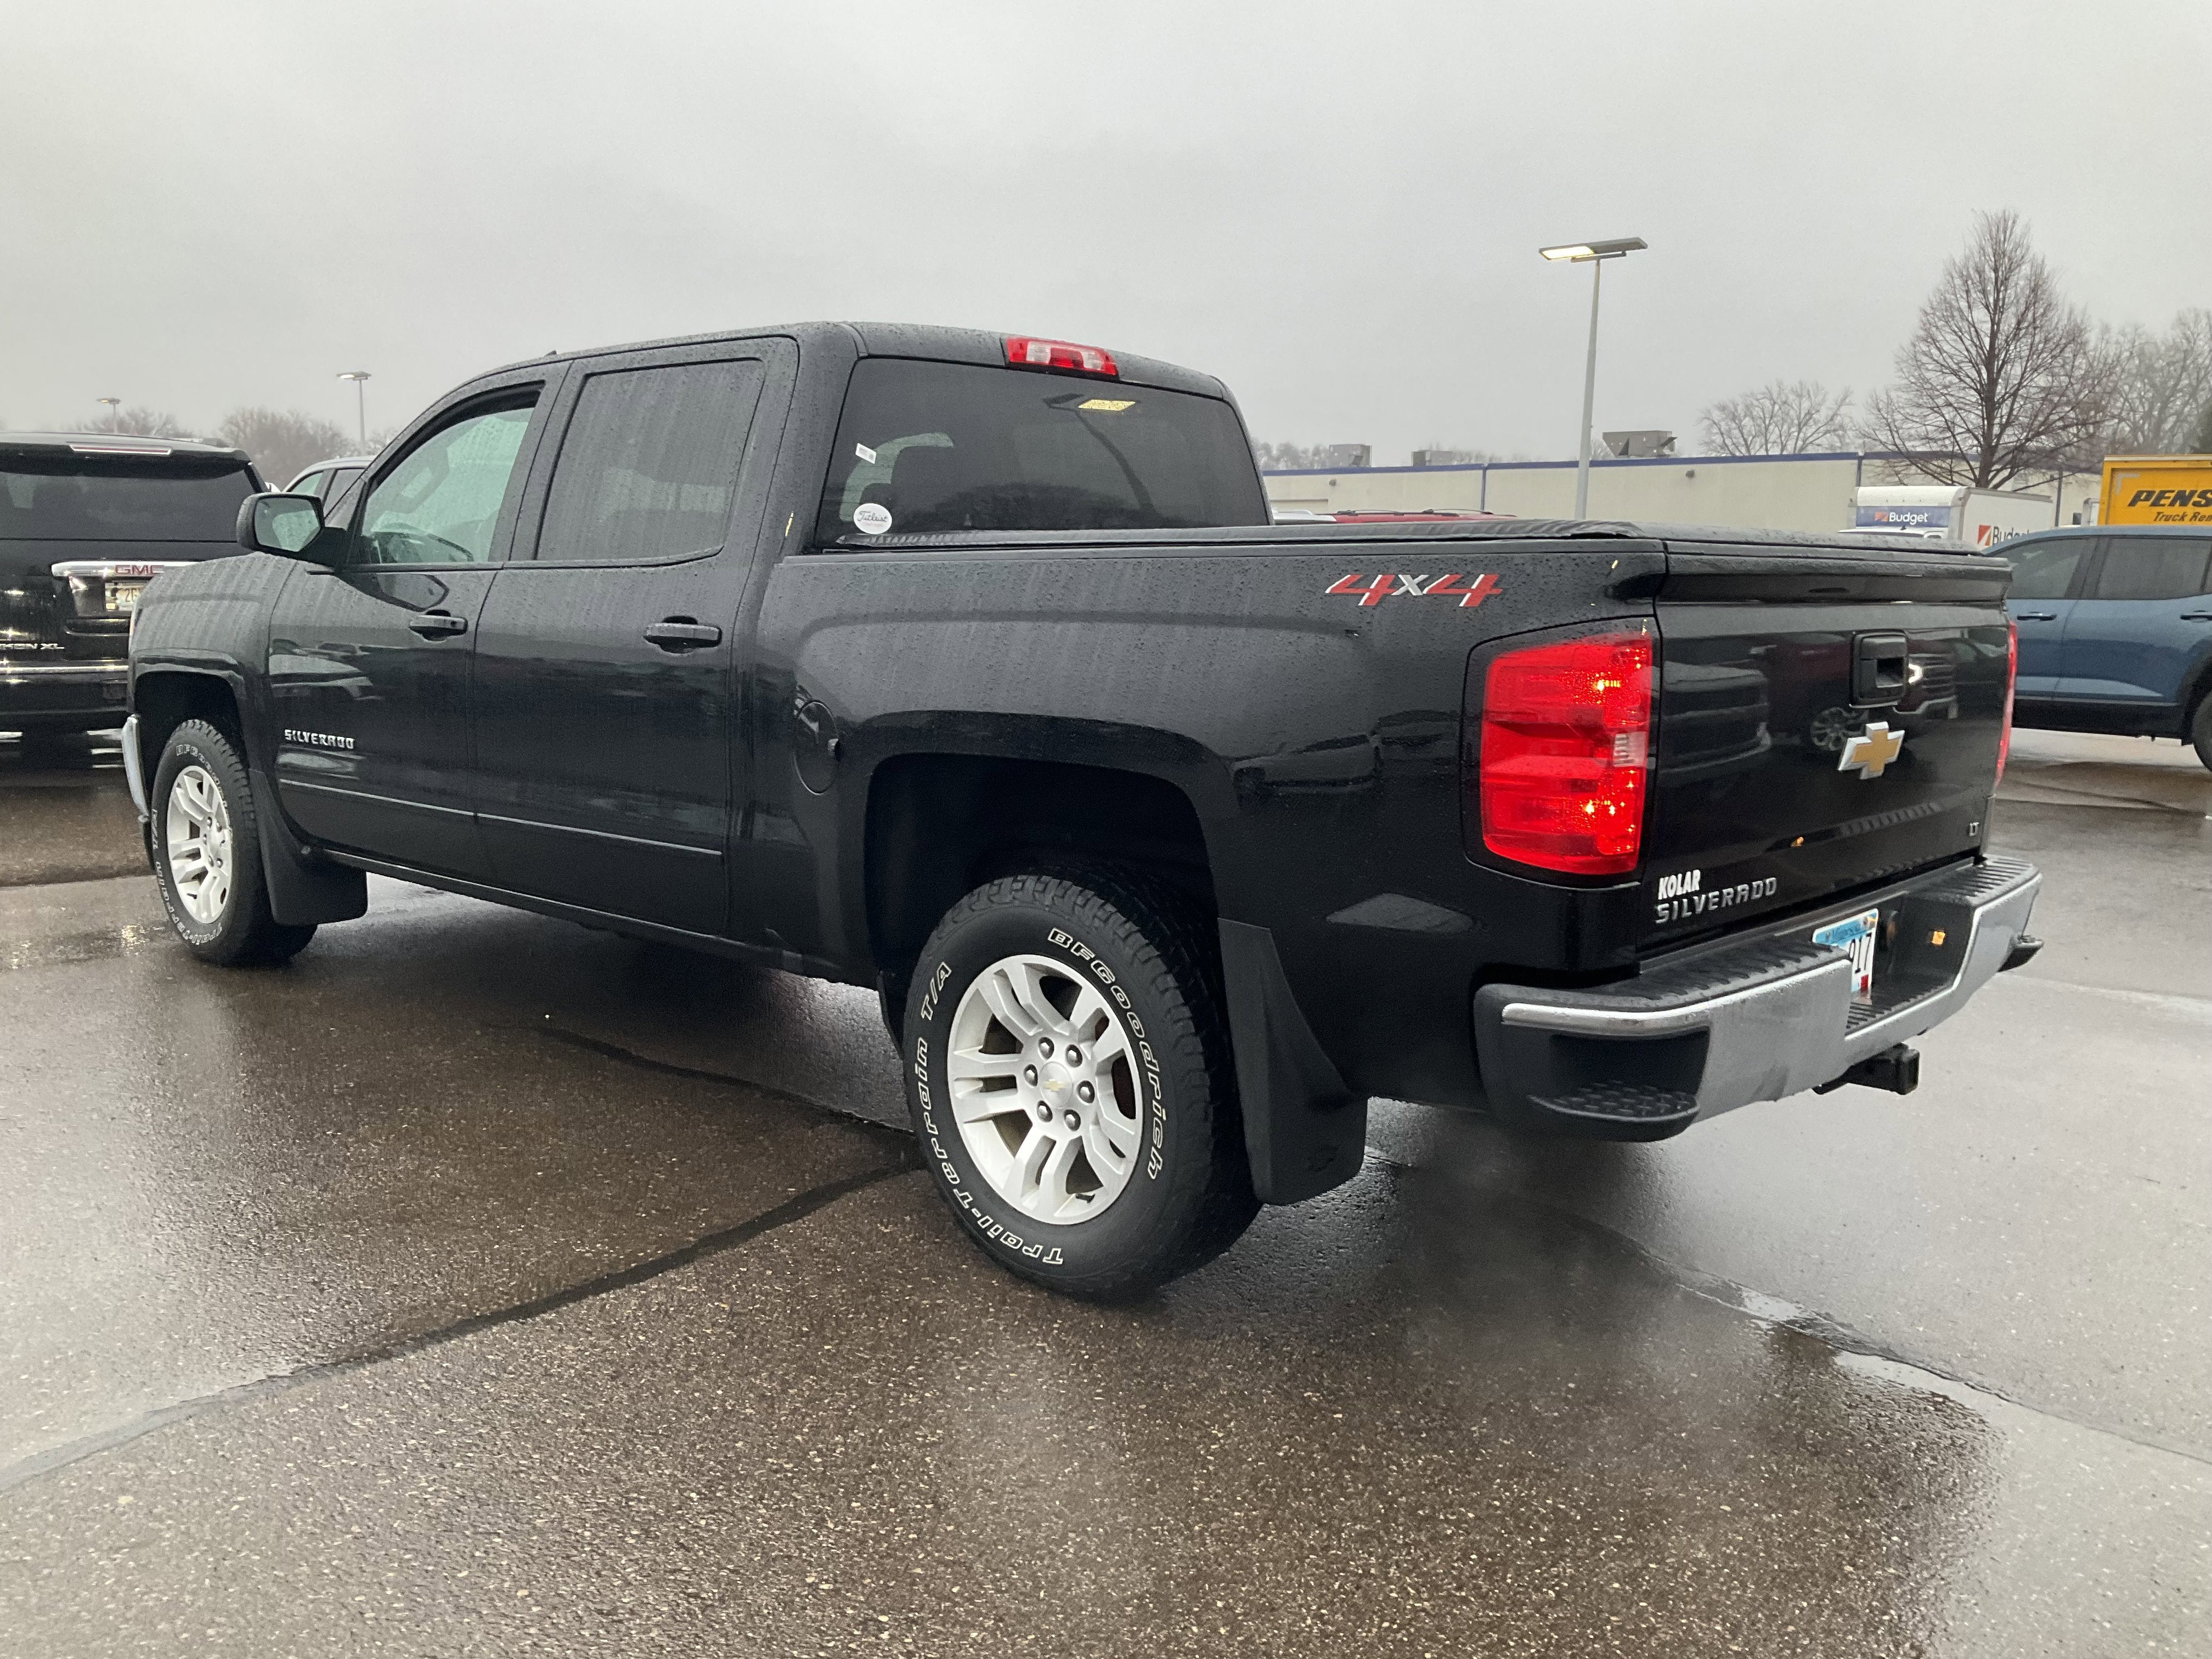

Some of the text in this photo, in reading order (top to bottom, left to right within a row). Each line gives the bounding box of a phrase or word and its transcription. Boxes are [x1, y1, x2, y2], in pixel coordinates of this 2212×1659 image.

[857, 511, 888, 522] Titleist
[1889, 512, 1928, 525] Budget
[2153, 511, 2188, 521] Truck
[115, 565, 165, 575] GMC
[284, 729, 356, 749] SILVERADO
[1657, 869, 1701, 900] KOLAR
[1655, 877, 1778, 924] SILVERADO
[921, 962, 952, 1021] T/A
[1048, 928, 1167, 1180] BFGoodrich
[915, 1037, 1064, 1265] Trail-Terrain
